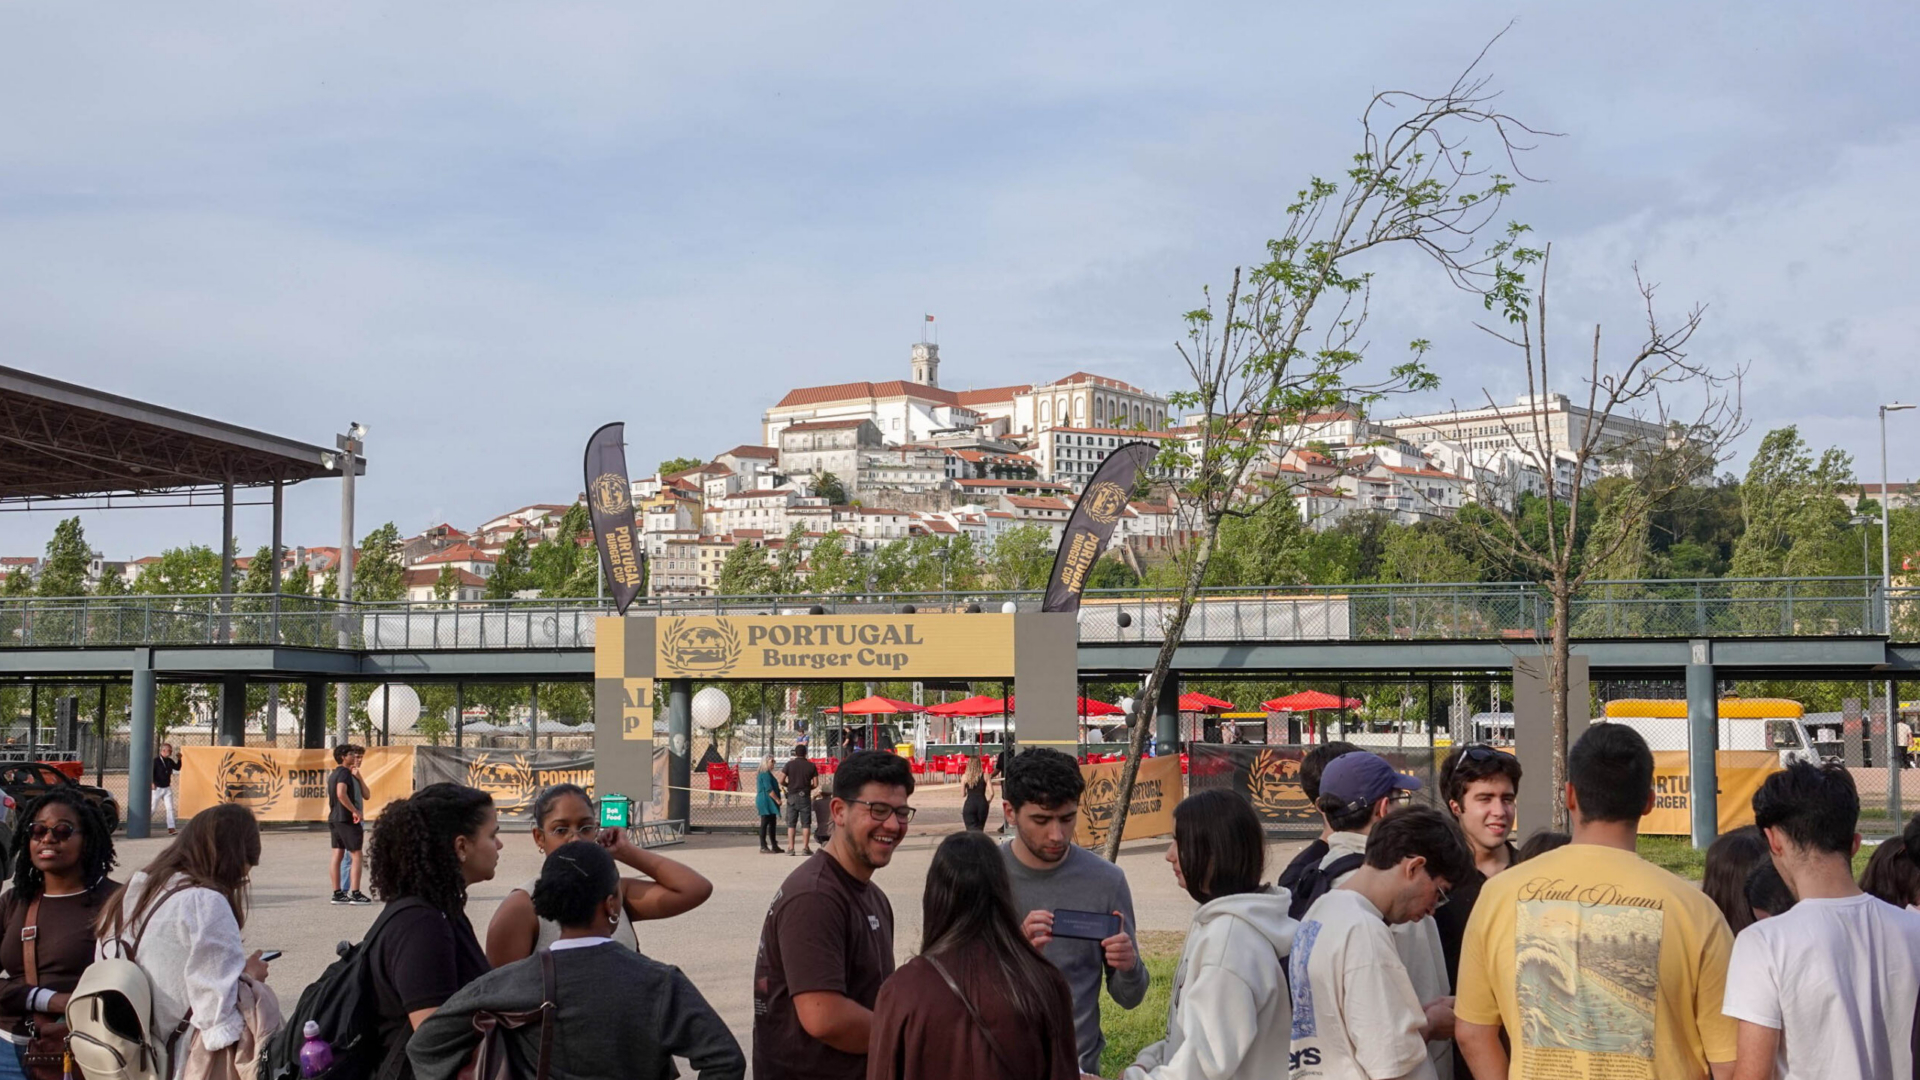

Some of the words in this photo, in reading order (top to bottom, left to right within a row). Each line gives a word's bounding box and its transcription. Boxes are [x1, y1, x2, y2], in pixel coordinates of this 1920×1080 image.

[605, 532, 621, 565] BURGER
[613, 566, 626, 584] CUP
[615, 525, 640, 588] PORTUGAL
[1065, 533, 1086, 566] BURGER
[1068, 532, 1100, 593] PORTUGAL
[1061, 566, 1074, 585] CUP
[747, 624, 924, 646] PORTUGAL
[762, 648, 853, 669] Burger
[857, 648, 909, 671] Cup
[539, 769, 595, 787] PORTUG
[1653, 795, 1687, 809] RGER
[1517, 876, 1578, 903] Kind
[1577, 883, 1664, 910] Dreams
